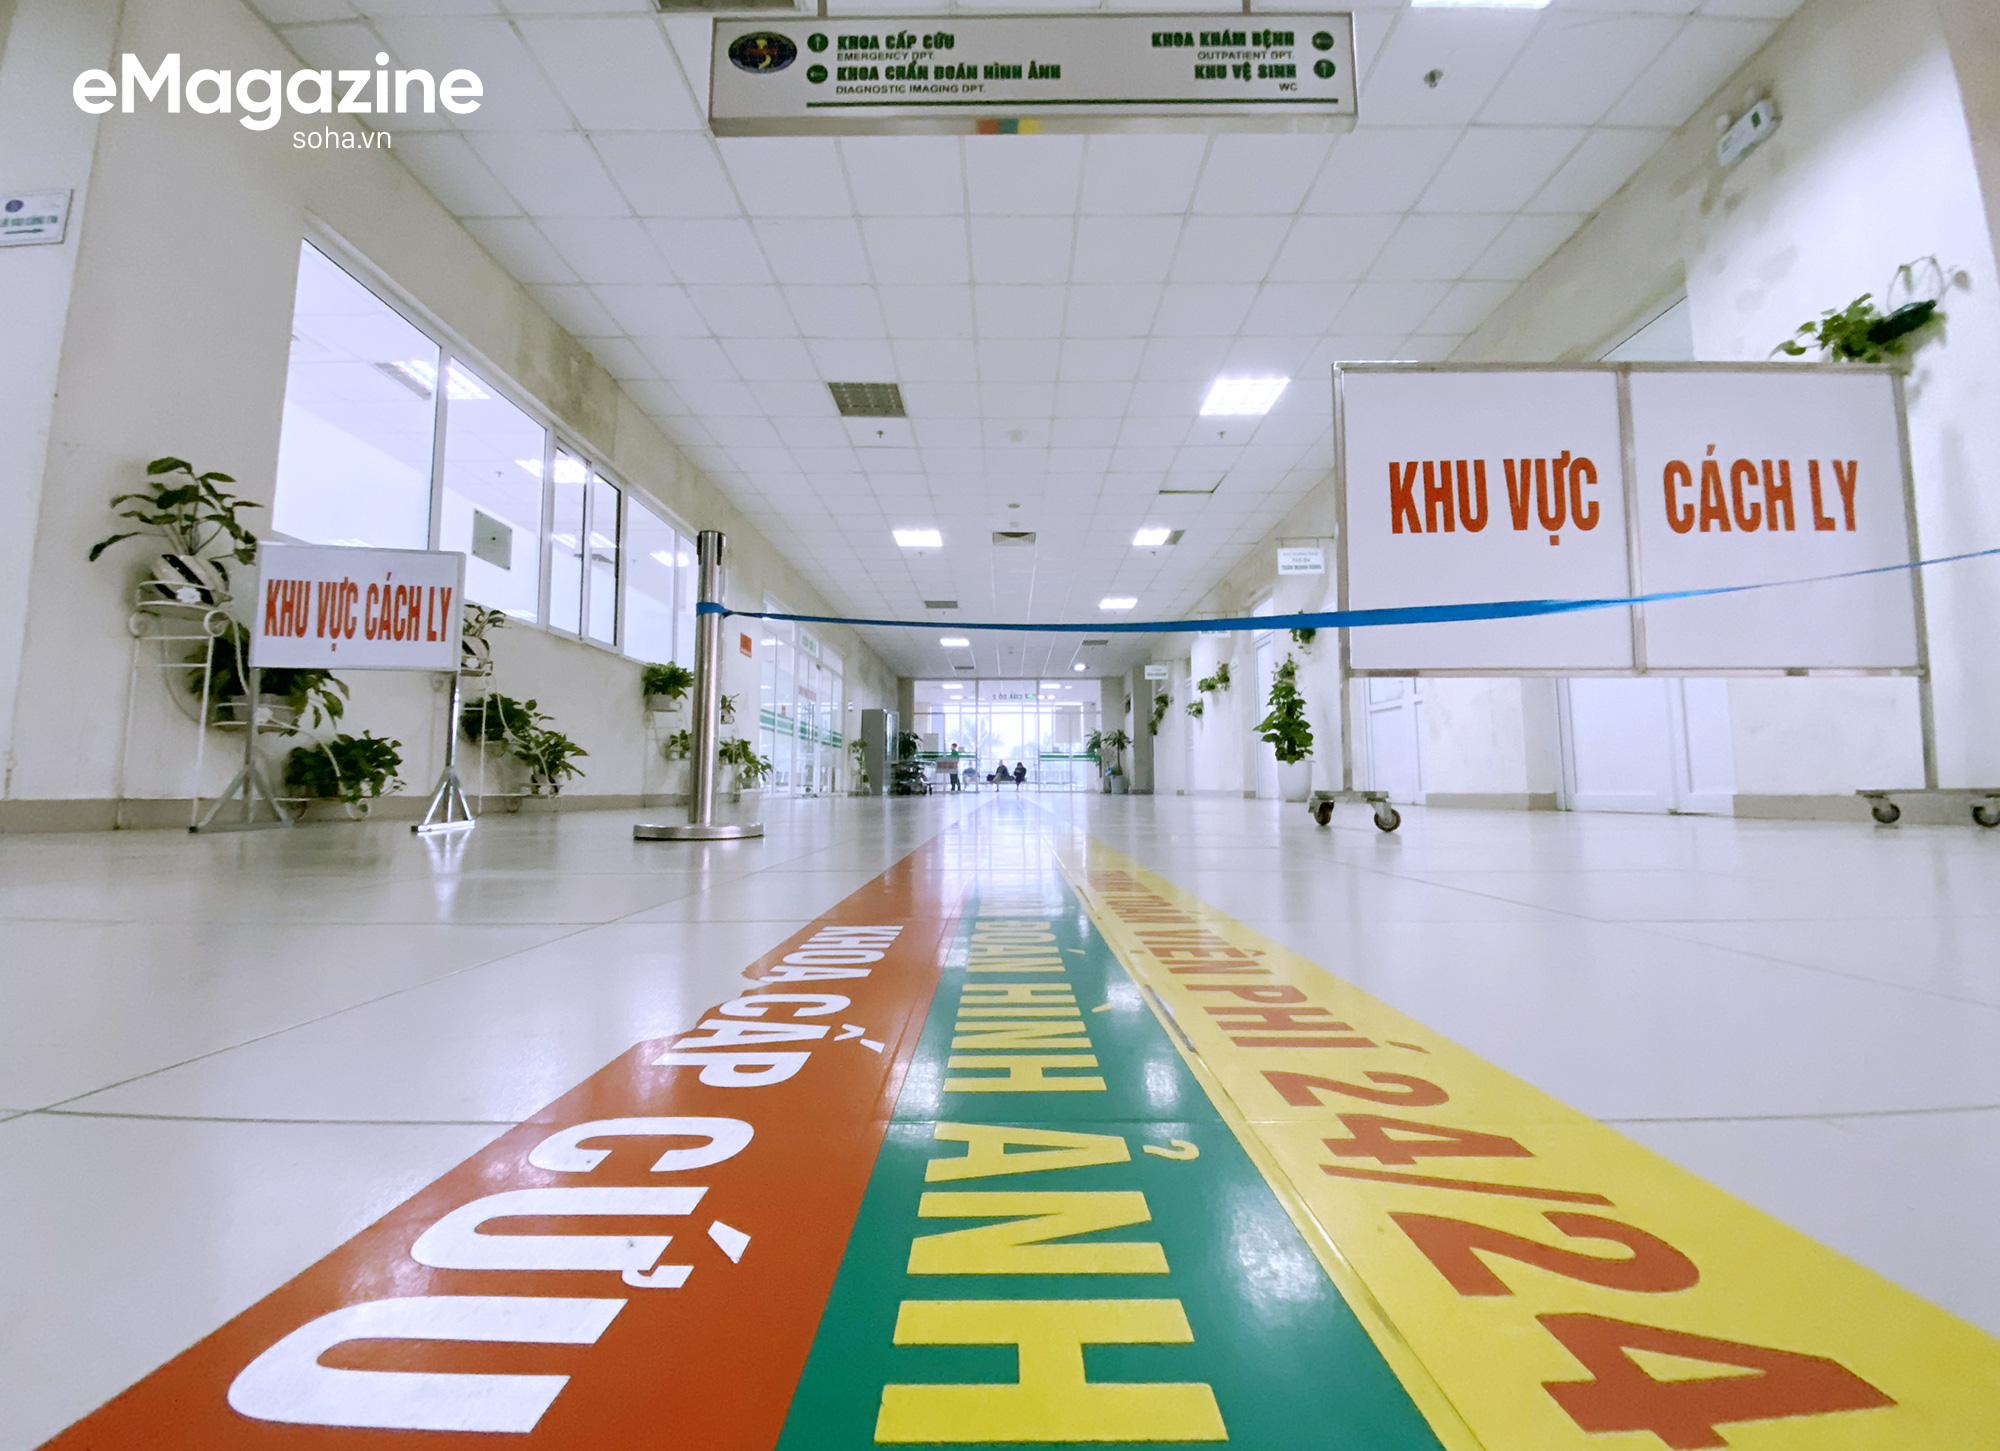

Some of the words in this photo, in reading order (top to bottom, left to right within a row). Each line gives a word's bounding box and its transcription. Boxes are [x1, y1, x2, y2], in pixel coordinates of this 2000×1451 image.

[837, 51, 909, 61] EMERGENCY
[838, 35, 880, 50] KHOA
[884, 30, 917, 50] CẤP
[922, 32, 955, 50] CỨU
[1151, 31, 1195, 48] KHOA
[1200, 29, 1246, 47] KHÁM
[1252, 28, 1295, 50] BỆNH
[1198, 51, 1266, 60] OUTPATIENT
[836, 65, 880, 81] KHOA
[836, 84, 906, 95] DIAGNOSTIC
[909, 84, 959, 94] IMAGING
[1194, 64, 1228, 80] KHU
[1257, 63, 1297, 79] SINH
[1278, 82, 1298, 92] WC
[1389, 459, 1489, 535] KHU
[1503, 450, 1600, 547] VỰC
[1663, 443, 1796, 535] CÁCH
[1808, 459, 1859, 532] LY
[264, 579, 311, 638] KHU
[317, 576, 359, 652] VỰC
[364, 572, 422, 641] CÁCH
[427, 586, 452, 642] LY
[1101, 895, 1202, 924] TOÁN
[759, 925, 905, 983] KHOA
[966, 920, 1086, 973] ĐOÁN
[1130, 929, 1274, 975] VIỆN
[650, 993, 886, 1088] CẤP
[943, 983, 1113, 1092] HÌNH
[1184, 983, 1430, 1053] PHÍ
[227, 1116, 755, 1434] CỨU
[873, 1121, 1230, 1442] ẢNH
[1260, 1070, 1899, 1450] 24/24
